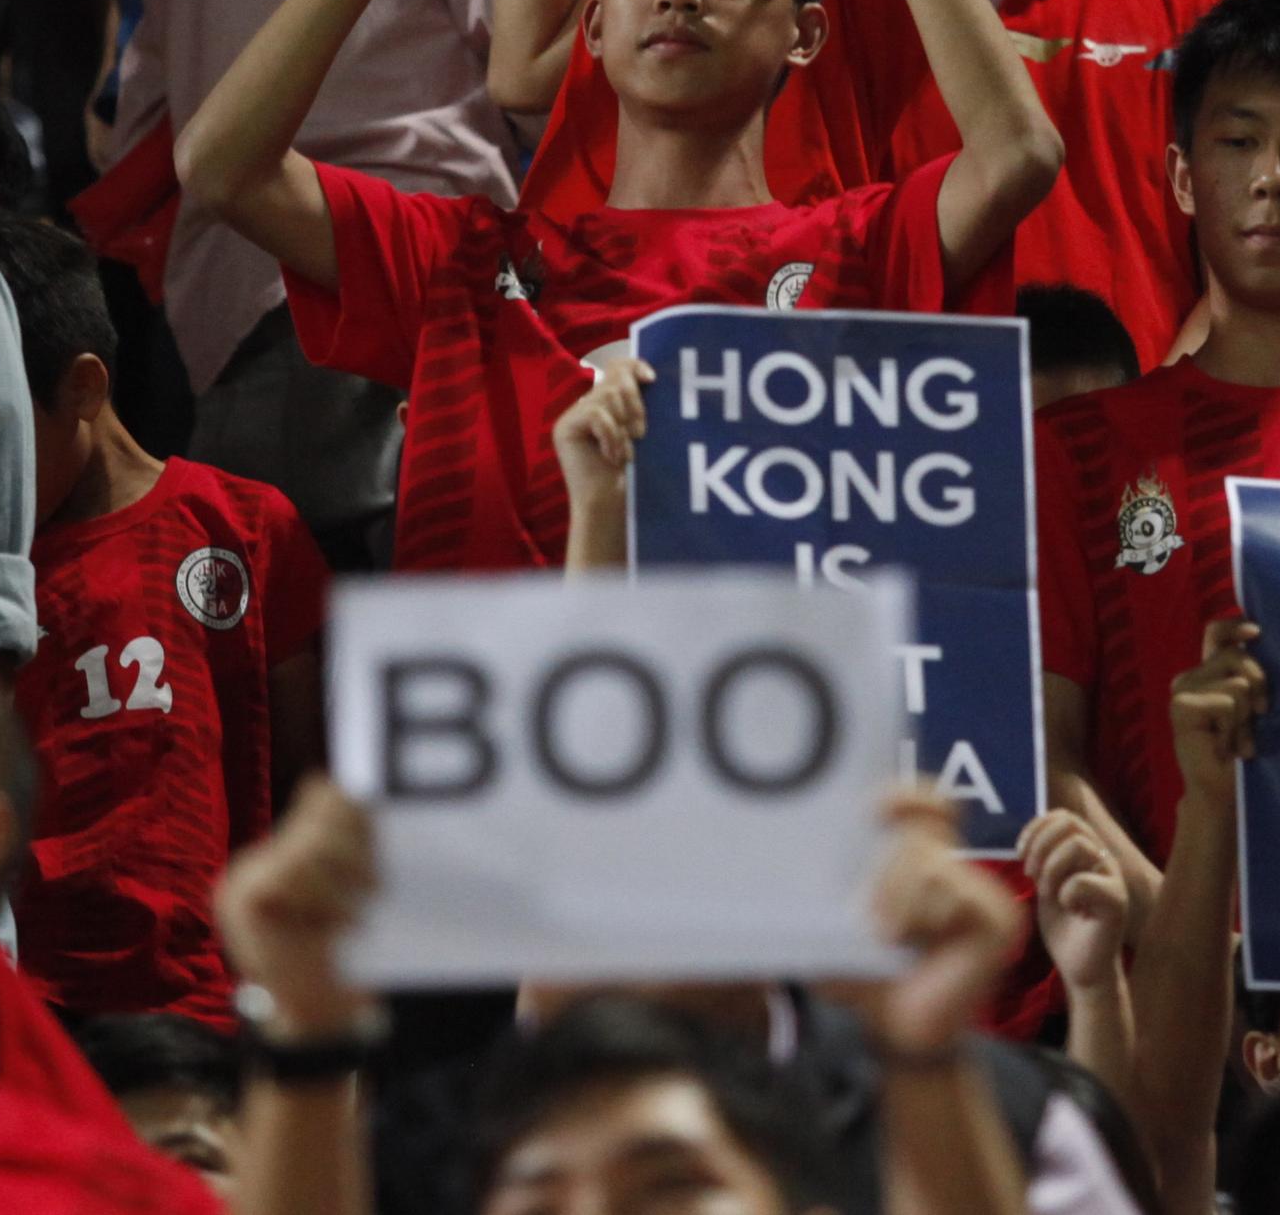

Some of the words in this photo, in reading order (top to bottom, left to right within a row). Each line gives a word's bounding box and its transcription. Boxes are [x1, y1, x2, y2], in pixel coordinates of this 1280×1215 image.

[679, 347, 980, 432] HONG
[687, 442, 977, 527] KONG
[74, 635, 173, 719] 12
[381, 641, 849, 801] BOO
